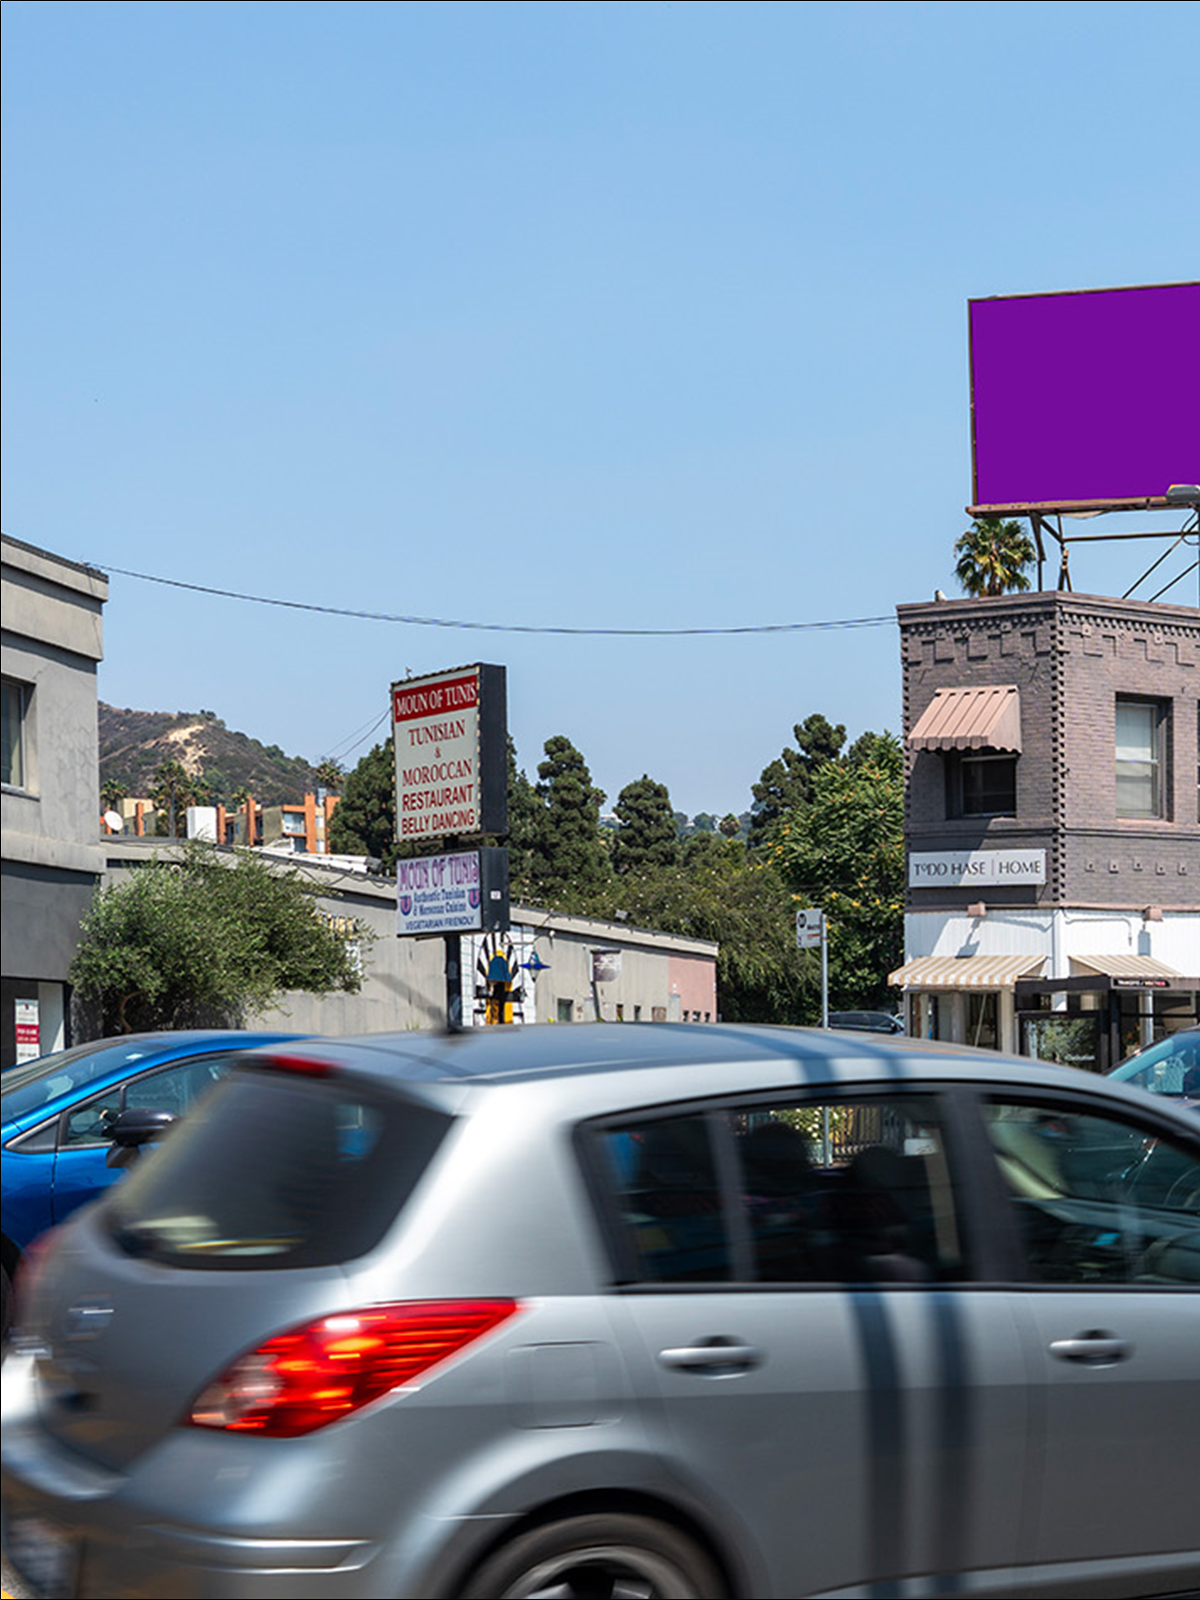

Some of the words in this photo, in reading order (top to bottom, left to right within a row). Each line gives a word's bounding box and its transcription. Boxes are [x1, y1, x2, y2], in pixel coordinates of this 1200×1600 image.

[396, 691, 429, 716] MOUN
[429, 688, 443, 710] OF
[444, 682, 477, 706] TUNIS
[408, 719, 466, 747] TUNISIAN
[434, 746, 442, 759] &
[402, 758, 473, 787] MOROCCAN
[402, 783, 474, 812] RESTAURANT
[402, 815, 431, 835] BELLY
[432, 808, 475, 831] DANCING
[399, 860, 429, 892] MOUN
[431, 857, 446, 888] OF
[448, 853, 478, 886] TUNIS
[951, 861, 986, 876] HASE
[999, 859, 1041, 874] HOME
[405, 918, 443, 931] VEGETARIAN
[444, 915, 475, 927] FRIENDLY
